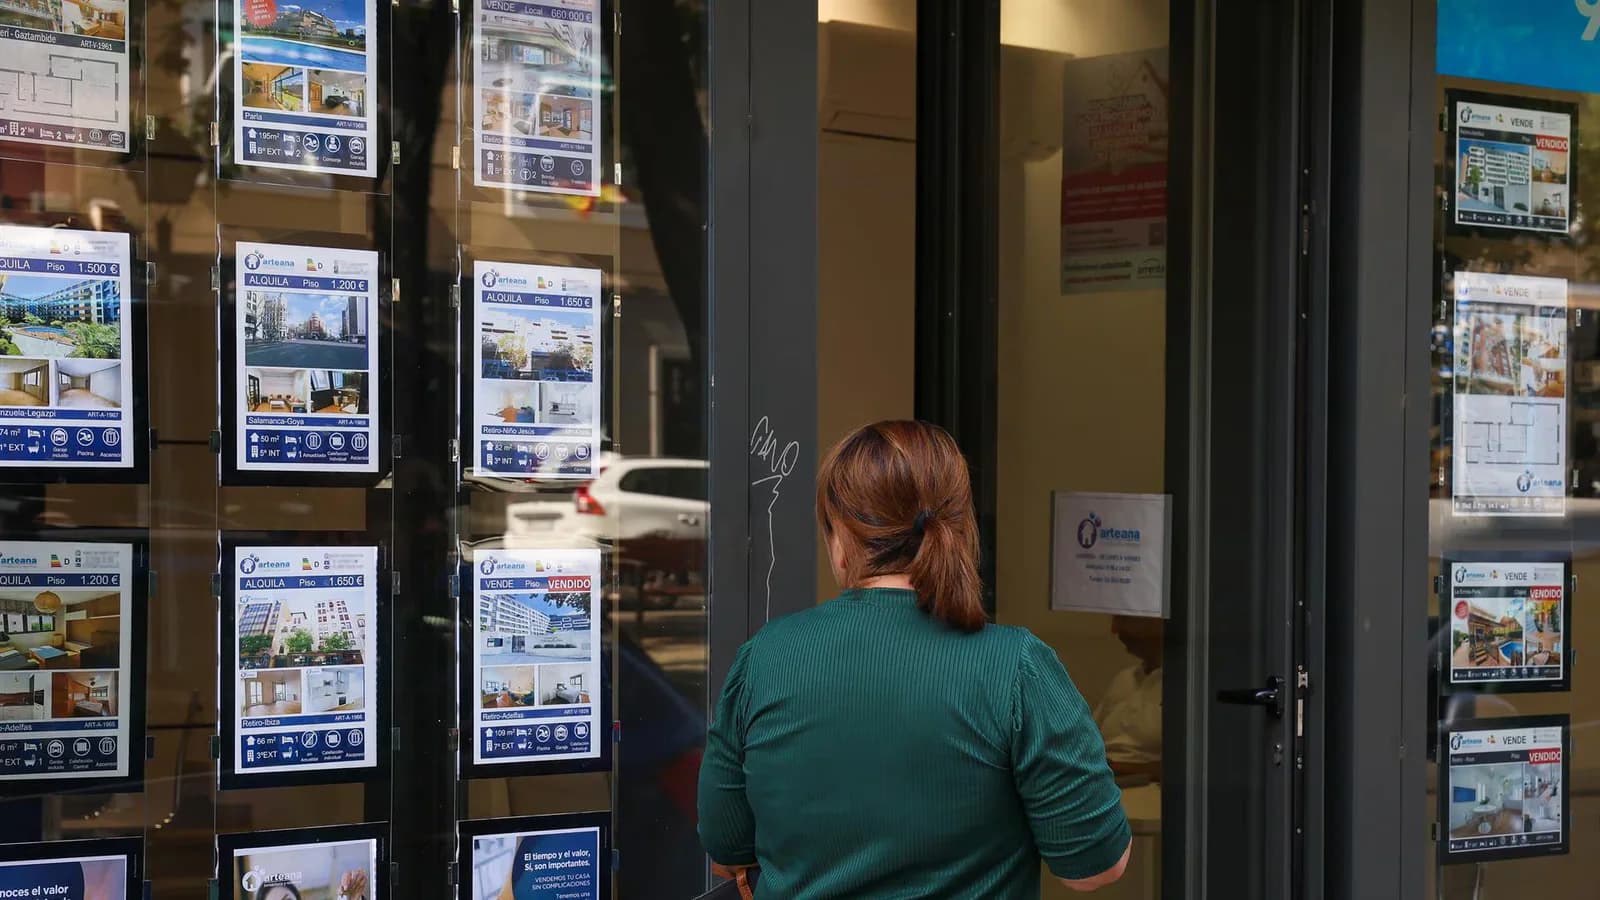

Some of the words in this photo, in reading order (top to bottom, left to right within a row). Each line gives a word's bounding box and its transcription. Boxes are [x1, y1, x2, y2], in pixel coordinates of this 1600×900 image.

[487, 0, 514, 12] VENDE
[525, 6, 543, 14] Local
[551, 8, 584, 20] 660.000
[586, 13, 592, 22] €
[15, 30, 56, 43] Gaztambide
[245, 112, 262, 121] Parla
[1510, 117, 1534, 129] VENDE
[1536, 136, 1568, 150] VENDIDO
[266, 147, 281, 156] EXT
[532, 170, 537, 179] 2
[262, 258, 295, 267] arteana
[47, 262, 65, 273] Piso
[79, 264, 106, 274] 1.500
[110, 264, 118, 274] €
[249, 275, 289, 287] ALQUILA
[303, 280, 319, 288] Piso
[331, 280, 356, 290] 1.200
[358, 281, 365, 291] €
[498, 277, 527, 285] arteana
[1503, 287, 1529, 297] VENDE
[486, 293, 522, 303] ALQUILA
[535, 297, 549, 305] Piso
[561, 297, 583, 308] 1.650
[584, 298, 590, 307] €
[248, 417, 305, 426] Salamanca-Goya
[10, 428, 21, 437] m²
[271, 435, 280, 443] m²
[268, 449, 280, 457] INT
[502, 457, 513, 465] INT
[1100, 528, 1140, 540] arteana
[0, 575, 31, 585] QUILA
[47, 576, 65, 585] Piso
[81, 575, 109, 585] 1.200
[111, 575, 118, 585] €
[1505, 572, 1527, 581] VENDE
[245, 579, 285, 589] ALQUILA
[299, 578, 316, 586] Piso
[329, 577, 354, 586] 1.650
[356, 576, 363, 586] €
[485, 579, 514, 589] VENDE
[525, 580, 540, 588] Piso
[548, 579, 591, 589] VENDIDO
[1530, 589, 1561, 599] VENDIDO
[482, 712, 524, 720] Retiro-Adelfas
[243, 719, 281, 727] Retiro-Ibiza
[1502, 735, 1527, 745] VENDE
[7, 743, 18, 751] m²
[502, 742, 514, 750] EXT
[1529, 751, 1561, 762] VENDIDO
[5, 758, 21, 766] EXT
[524, 853, 532, 861] El
[532, 852, 557, 862] tiempo
[564, 850, 571, 858] el
[571, 849, 591, 858] valor,
[534, 862, 547, 870] son
[548, 860, 590, 869] importantes.
[535, 874, 567, 883] VENDEMOS
[541, 880, 591, 889] COMPLICACIONES
[0, 889, 29, 898] noces
[32, 886, 41, 896] el
[43, 884, 69, 895] valor
[556, 892, 580, 900] Tenemos
